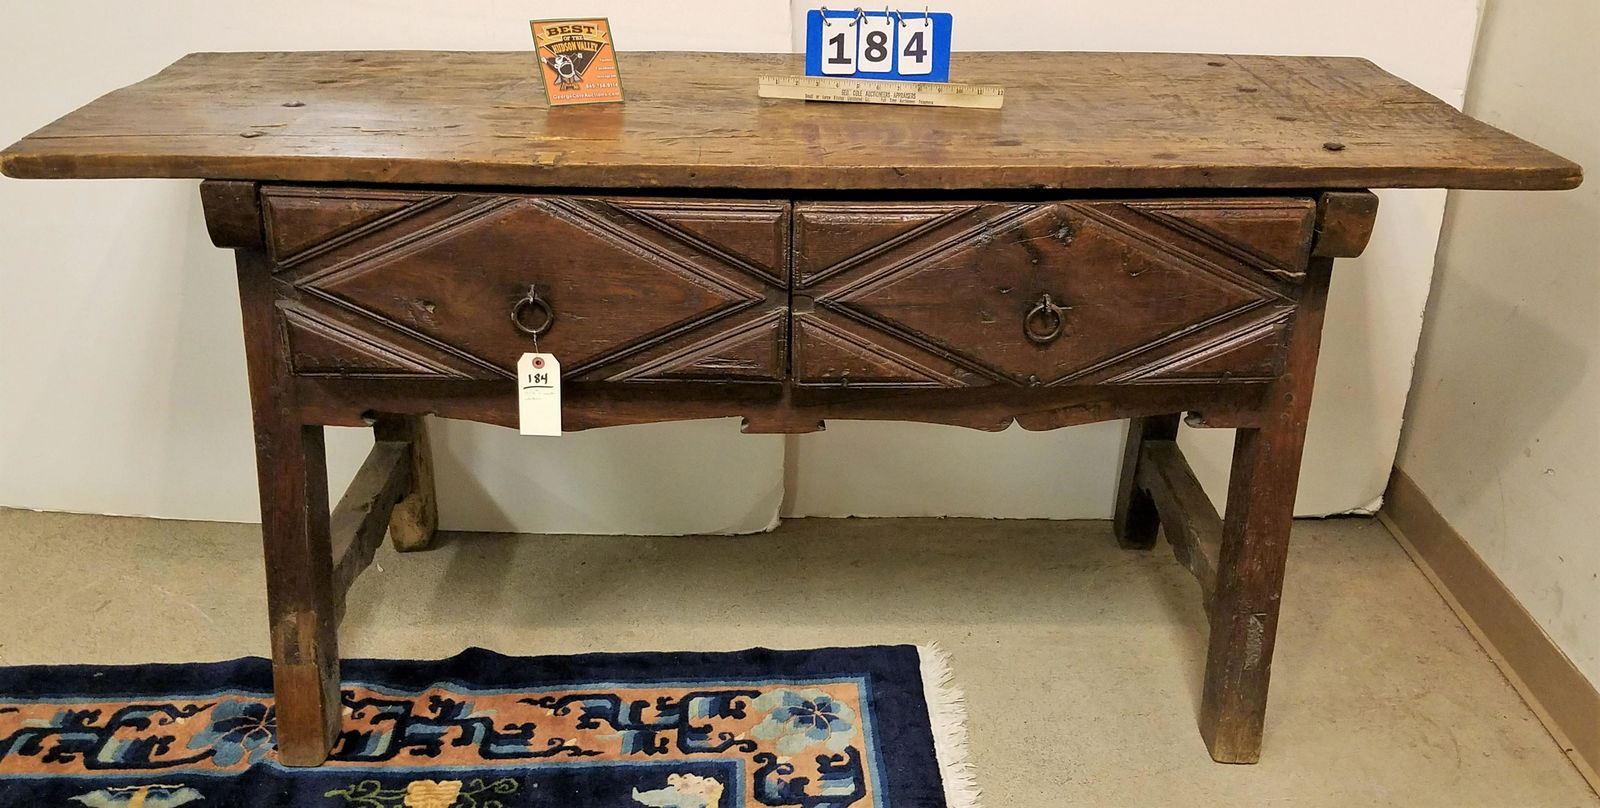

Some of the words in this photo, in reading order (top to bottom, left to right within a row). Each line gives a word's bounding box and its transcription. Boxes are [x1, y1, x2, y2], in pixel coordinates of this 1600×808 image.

[546, 25, 595, 37] BEST
[551, 41, 577, 54] HUDSON
[577, 41, 599, 53] VALLEY
[828, 30, 928, 65] 184
[528, 373, 548, 385] 184
